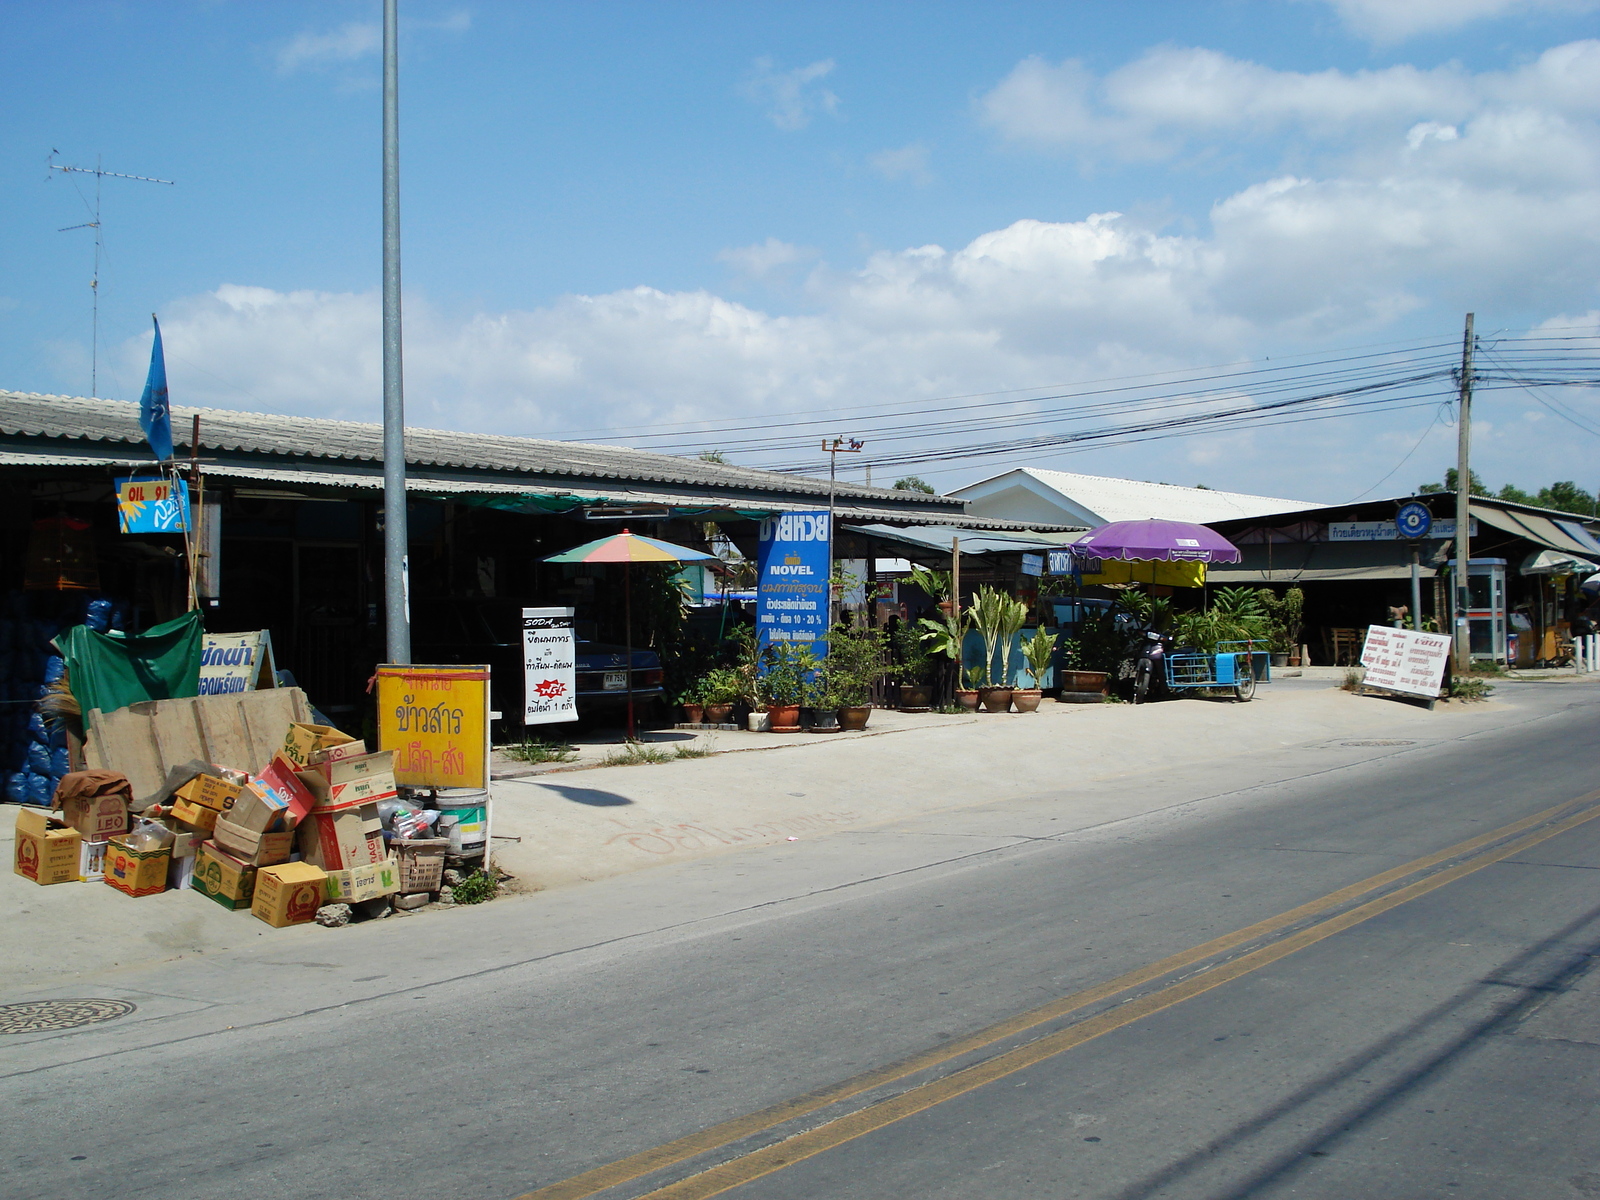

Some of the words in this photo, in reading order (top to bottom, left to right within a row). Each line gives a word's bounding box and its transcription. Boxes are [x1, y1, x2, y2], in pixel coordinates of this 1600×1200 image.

[128, 487, 144, 501] OIL
[155, 486, 167, 500] 91
[770, 565, 814, 575] NOVEL
[524, 618, 553, 626] SODA
[794, 615, 801, 624] 10
[806, 615, 815, 624] 20
[816, 614, 822, 625] %
[554, 702, 558, 711] 1
[395, 694, 464, 735] ข้าวสาร
[395, 740, 465, 776] ปลีก-ส่ง
[97, 815, 124, 832] LEO
